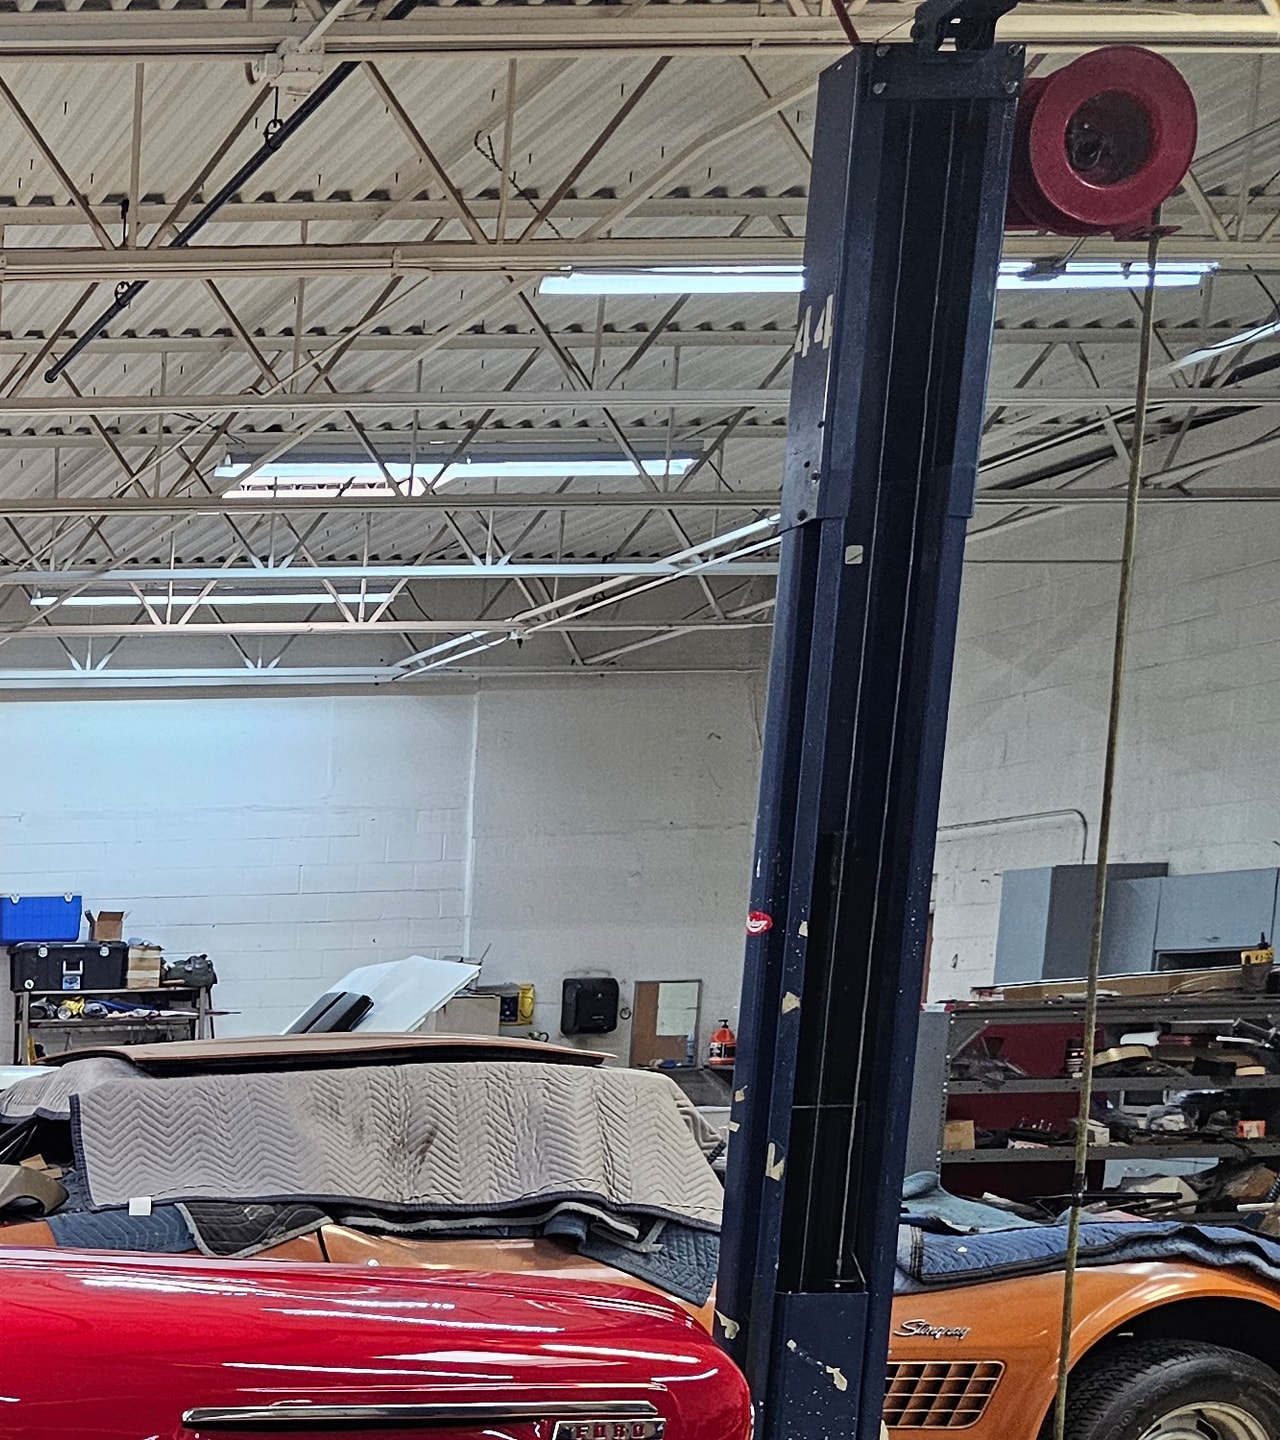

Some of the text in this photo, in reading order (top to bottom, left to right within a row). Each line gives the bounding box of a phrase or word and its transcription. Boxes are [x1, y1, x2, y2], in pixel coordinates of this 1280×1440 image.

[793, 293, 834, 359] 44
[893, 1318, 972, 1340] Stingray
[574, 1422, 647, 1440] FORD
